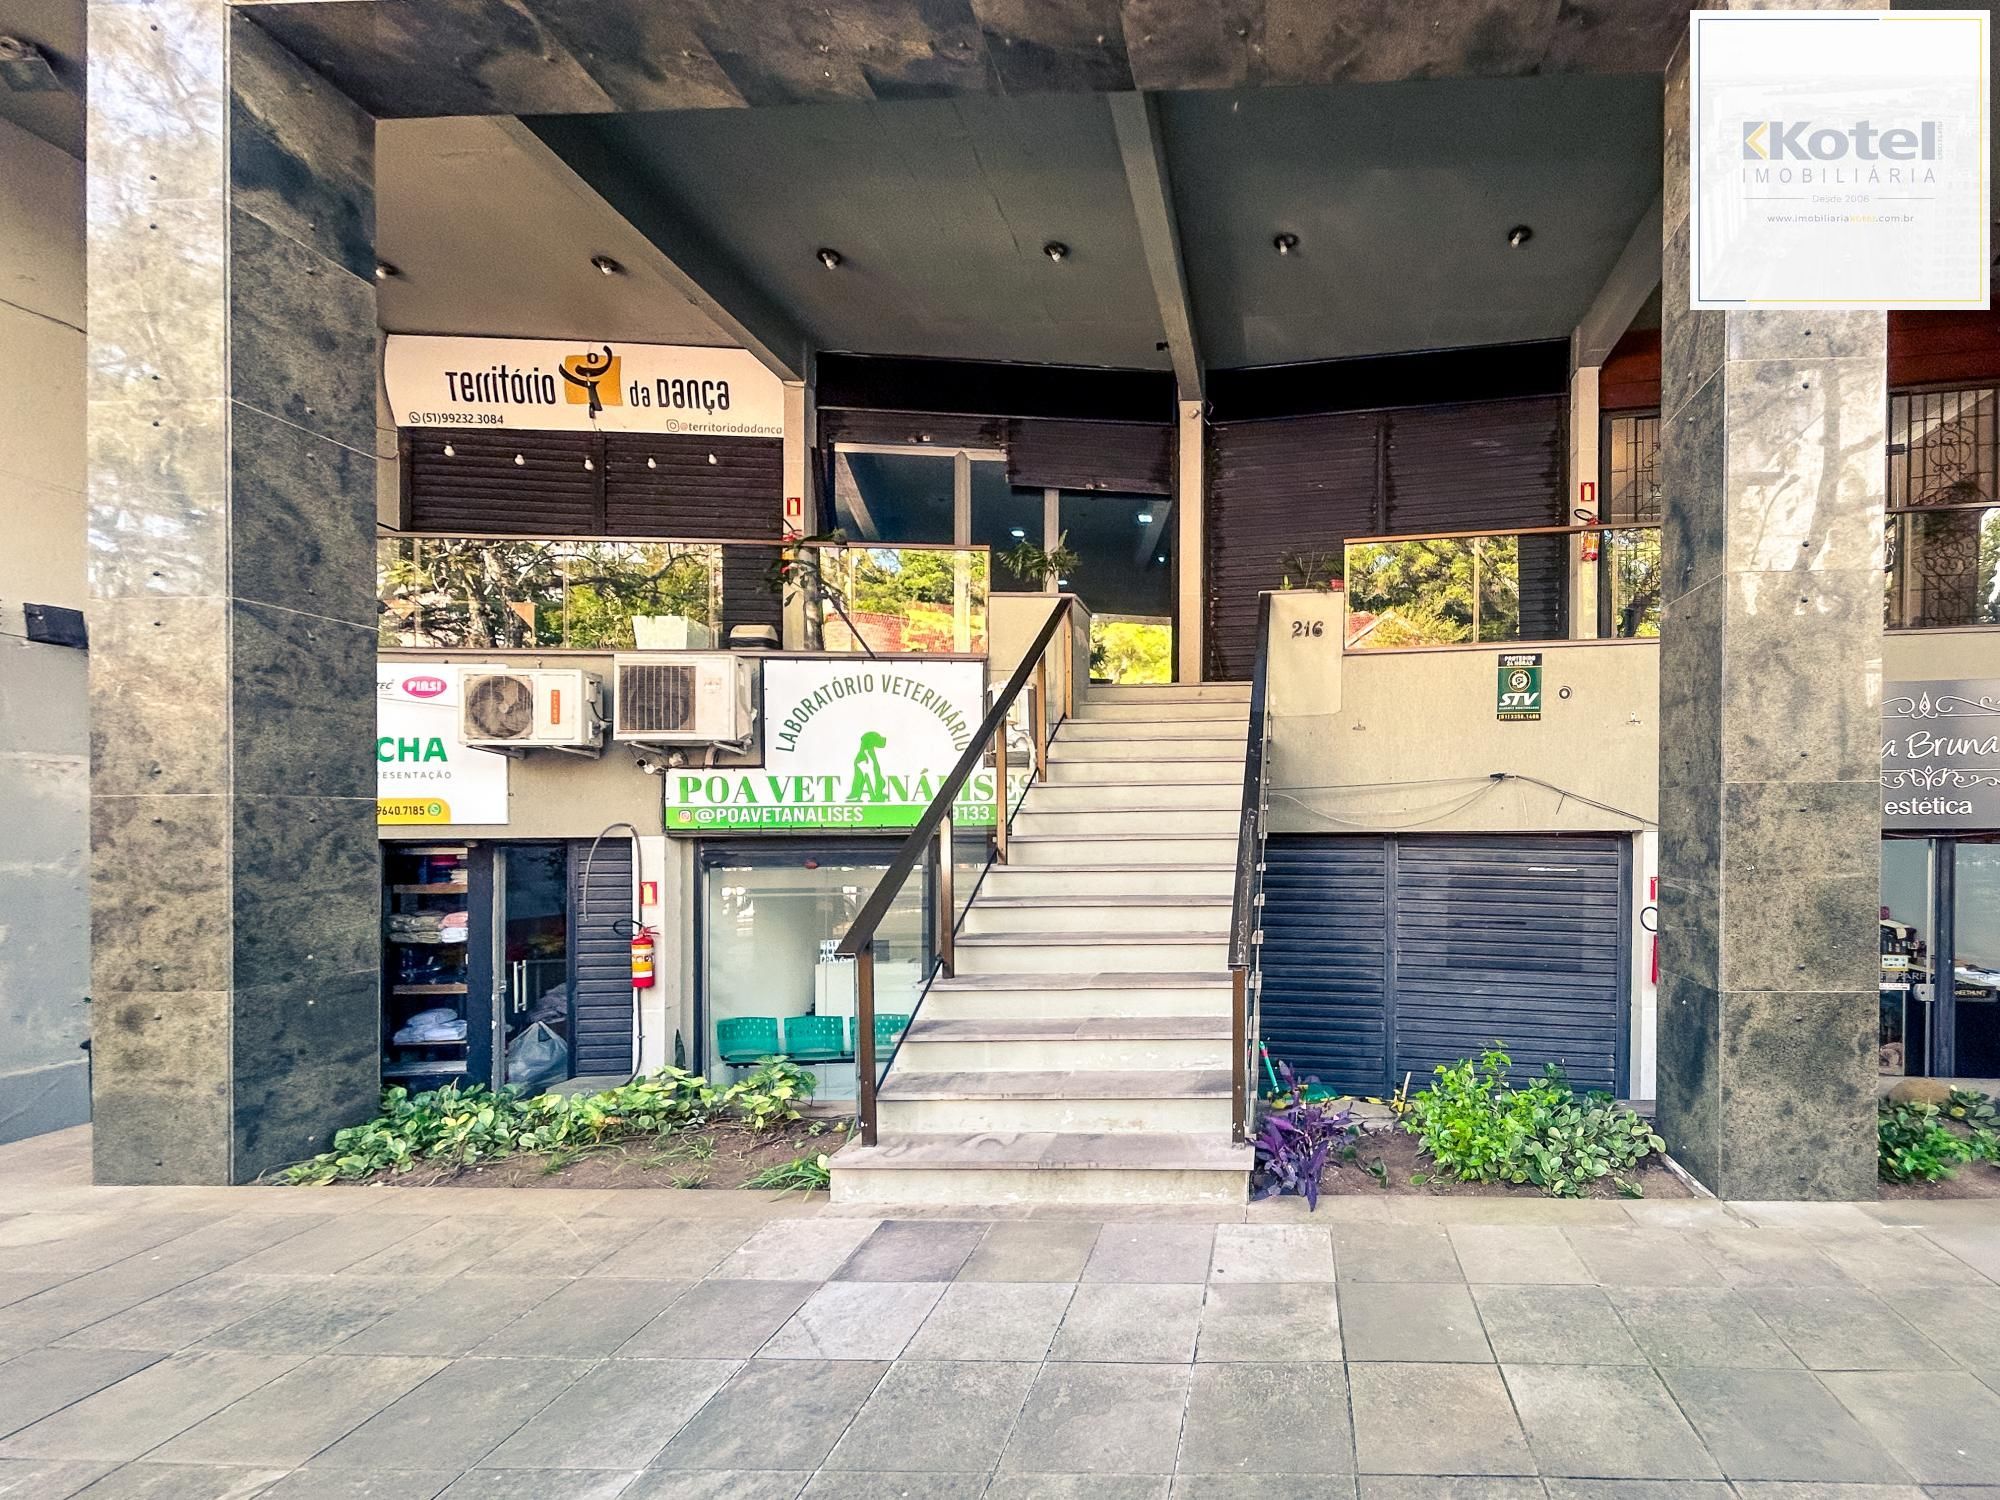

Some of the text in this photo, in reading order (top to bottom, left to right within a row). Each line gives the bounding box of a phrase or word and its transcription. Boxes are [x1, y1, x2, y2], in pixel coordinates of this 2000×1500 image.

[445, 364, 731, 415] Território da Dança
[1291, 620, 1324, 639] 216
[1498, 692, 1539, 706] STV
[775, 673, 971, 753] LABORATÓRIO VETERINÁRIO
[1904, 730, 1999, 760] Bruna
[377, 770, 452, 780] ESENTAÇÃO
[677, 775, 759, 804] POA
[766, 775, 842, 804] VET
[695, 806, 865, 824] @POAVETANALISES
[1884, 797, 1973, 815] estética
